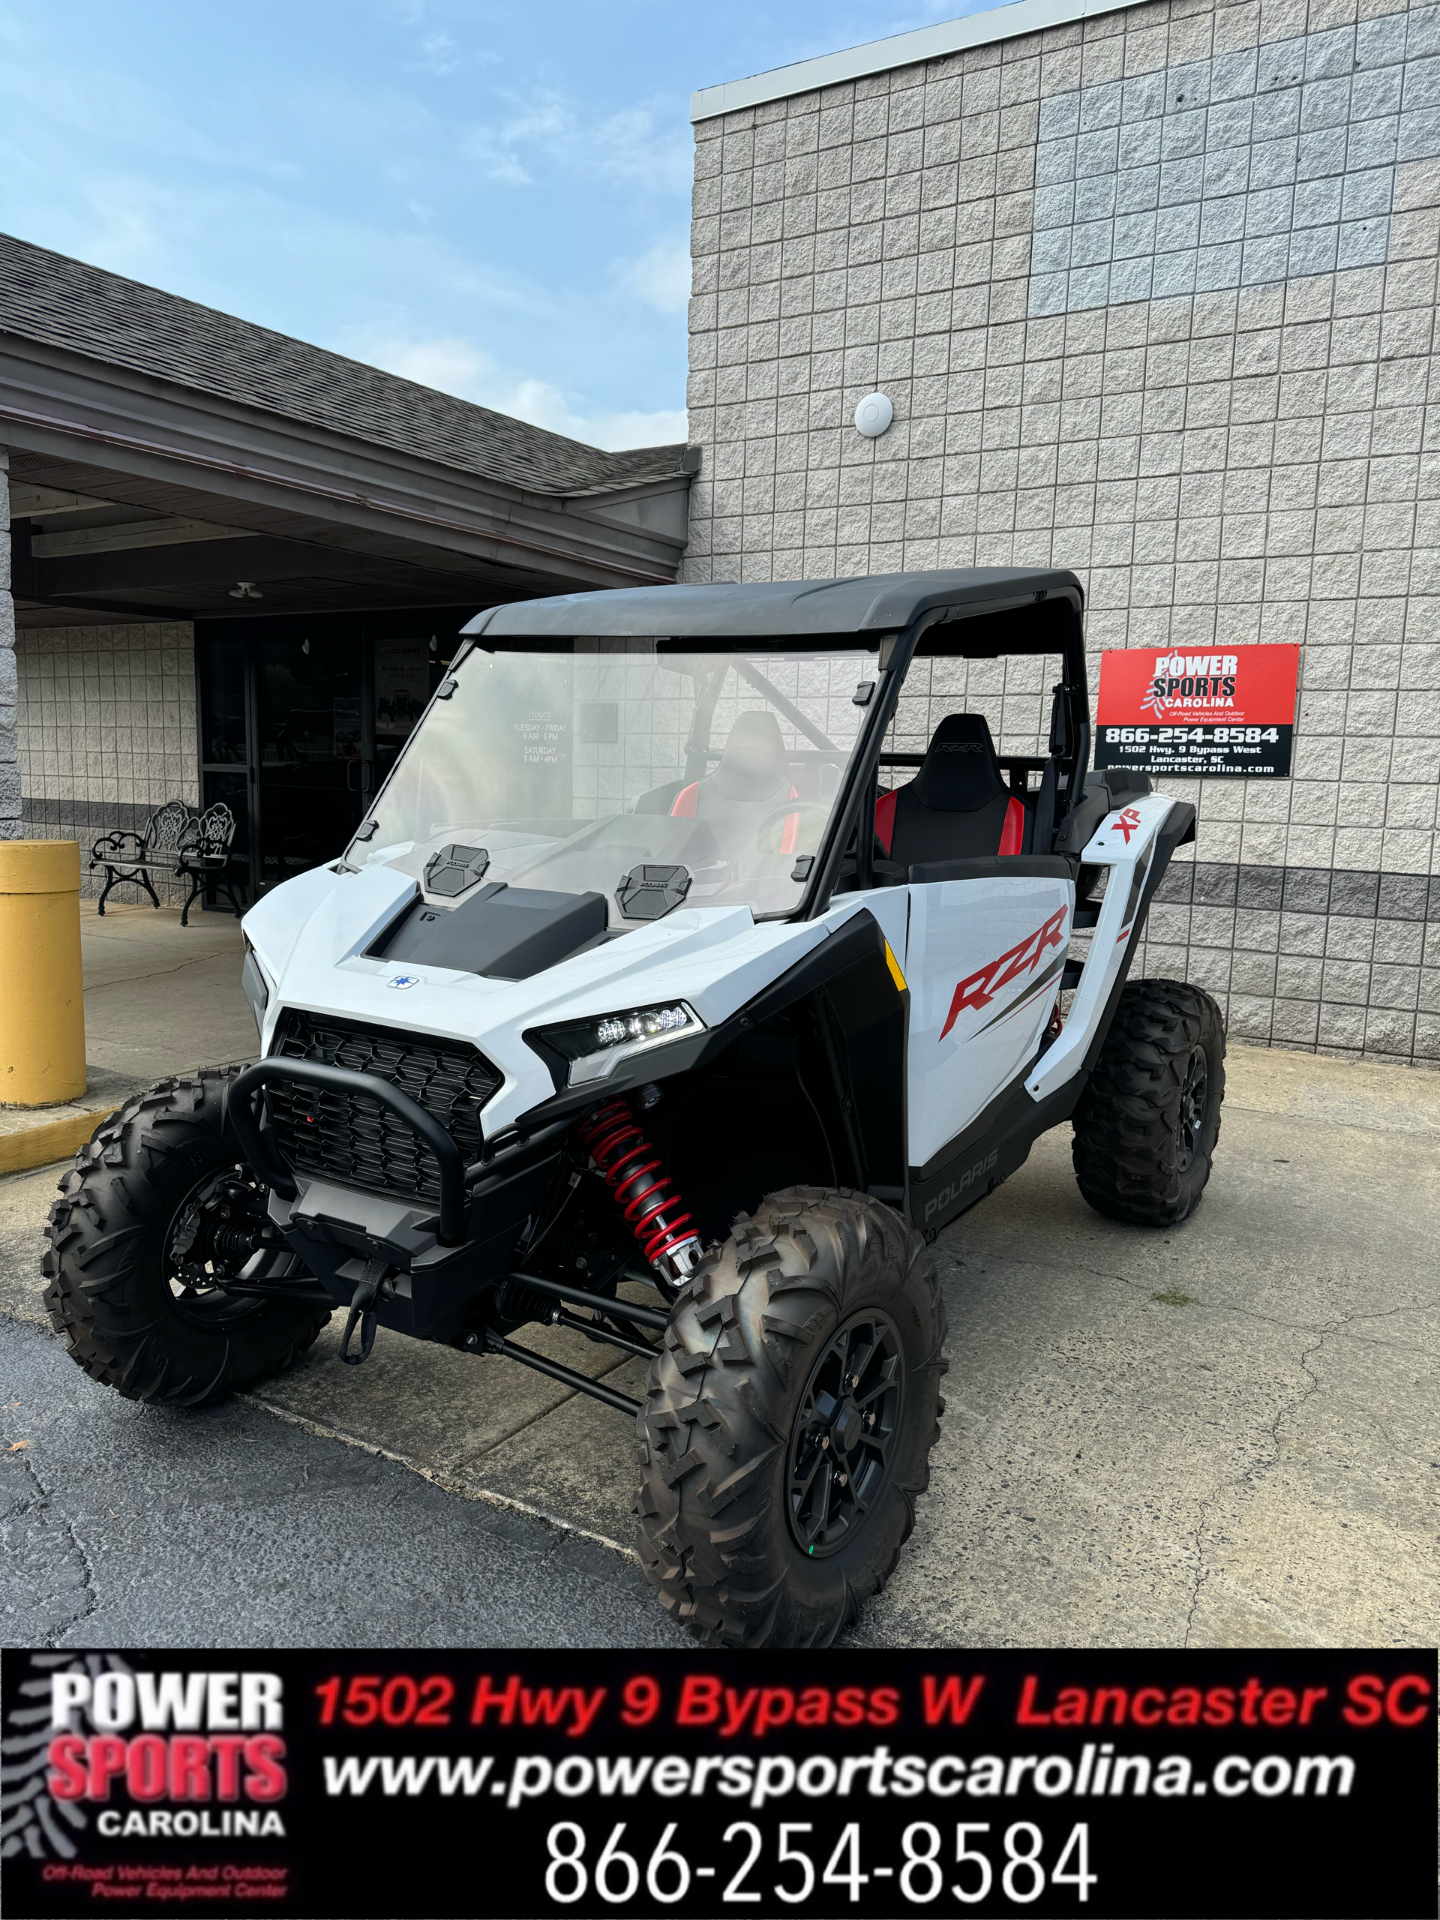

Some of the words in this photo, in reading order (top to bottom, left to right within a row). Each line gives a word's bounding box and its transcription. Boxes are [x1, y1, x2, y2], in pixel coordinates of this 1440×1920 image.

[1155, 655, 1238, 677] POWER
[1153, 676, 1236, 698] SPORTS
[1164, 697, 1234, 708] CAROLINA
[528, 709, 552, 719] Hours
[514, 724, 541, 732] TUESDAY
[546, 724, 567, 732] FRIDAY
[523, 732, 528, 741] 9
[528, 732, 539, 741] AM
[544, 732, 548, 741] 6
[549, 732, 558, 741] PM
[1105, 727, 1279, 743] 866-254-8584
[524, 746, 557, 755] SATURDAY
[1149, 746, 1175, 755] Hwy.
[1189, 746, 1230, 755] Bypass
[1233, 746, 1262, 754] West
[523, 755, 528, 763] 9
[529, 755, 540, 763] AM
[1151, 756, 1207, 764] Lancaster,
[1211, 756, 1224, 764] SC
[1111, 808, 1142, 845] XP
[938, 904, 1068, 1042] RZR
[925, 1147, 999, 1224] POLARIS
